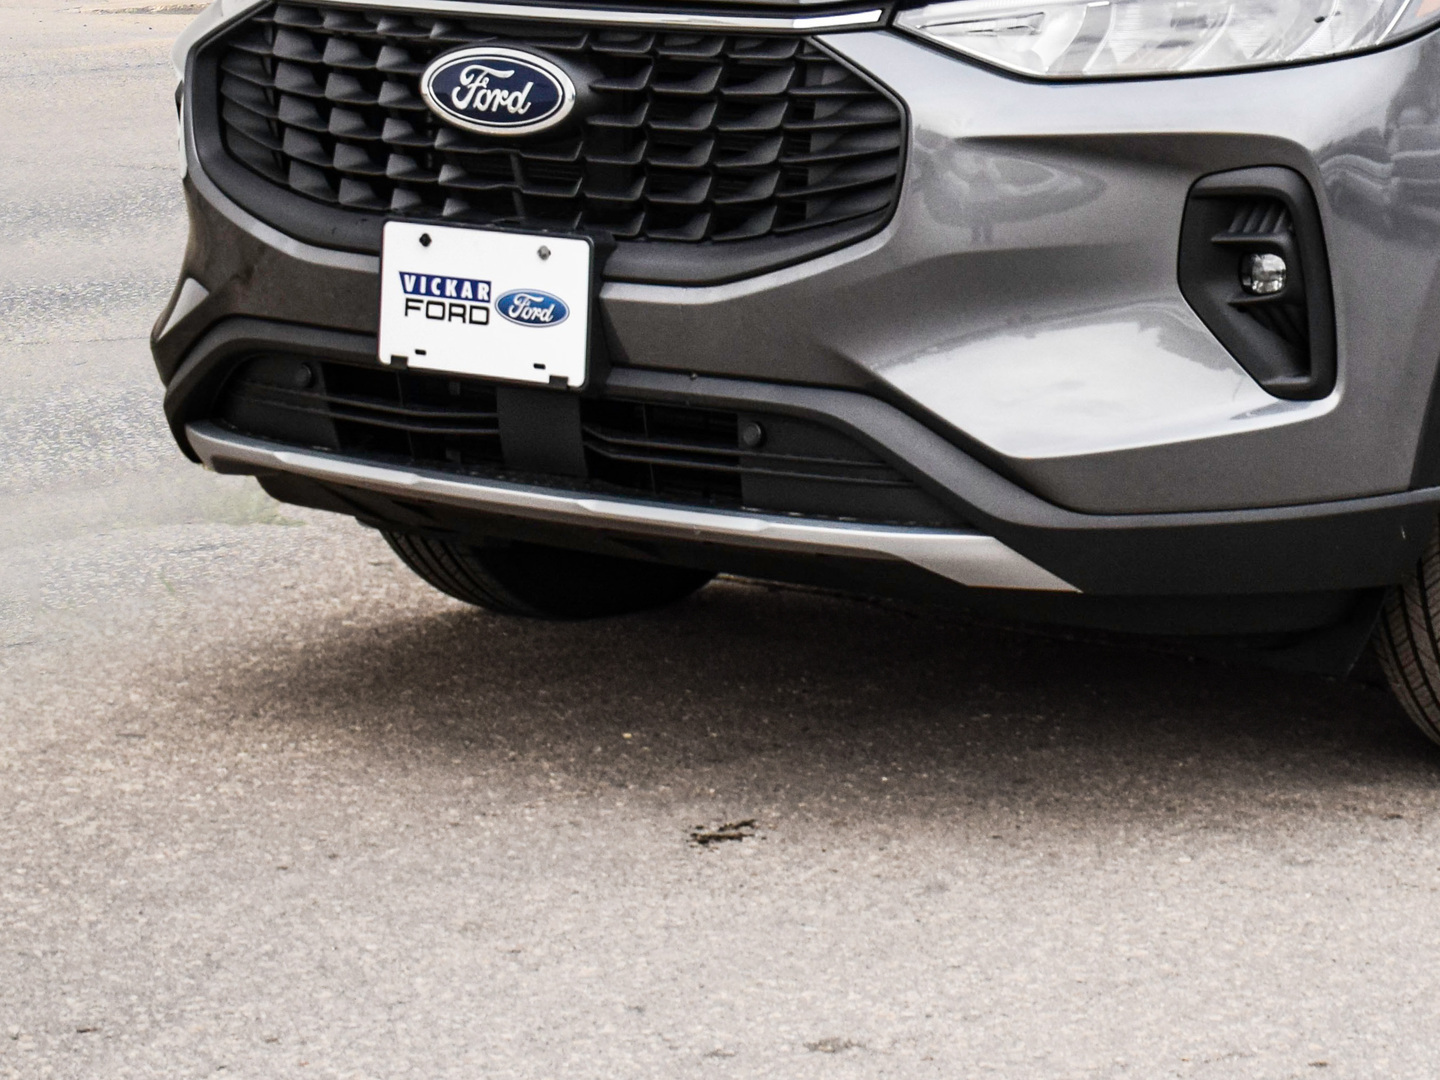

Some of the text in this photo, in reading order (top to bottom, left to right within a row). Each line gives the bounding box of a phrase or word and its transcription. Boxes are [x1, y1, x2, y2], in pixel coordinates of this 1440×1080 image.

[451, 64, 535, 116] Ford
[403, 273, 490, 302] VICKAR
[404, 297, 490, 327] FORD
[507, 292, 555, 324] Ford
